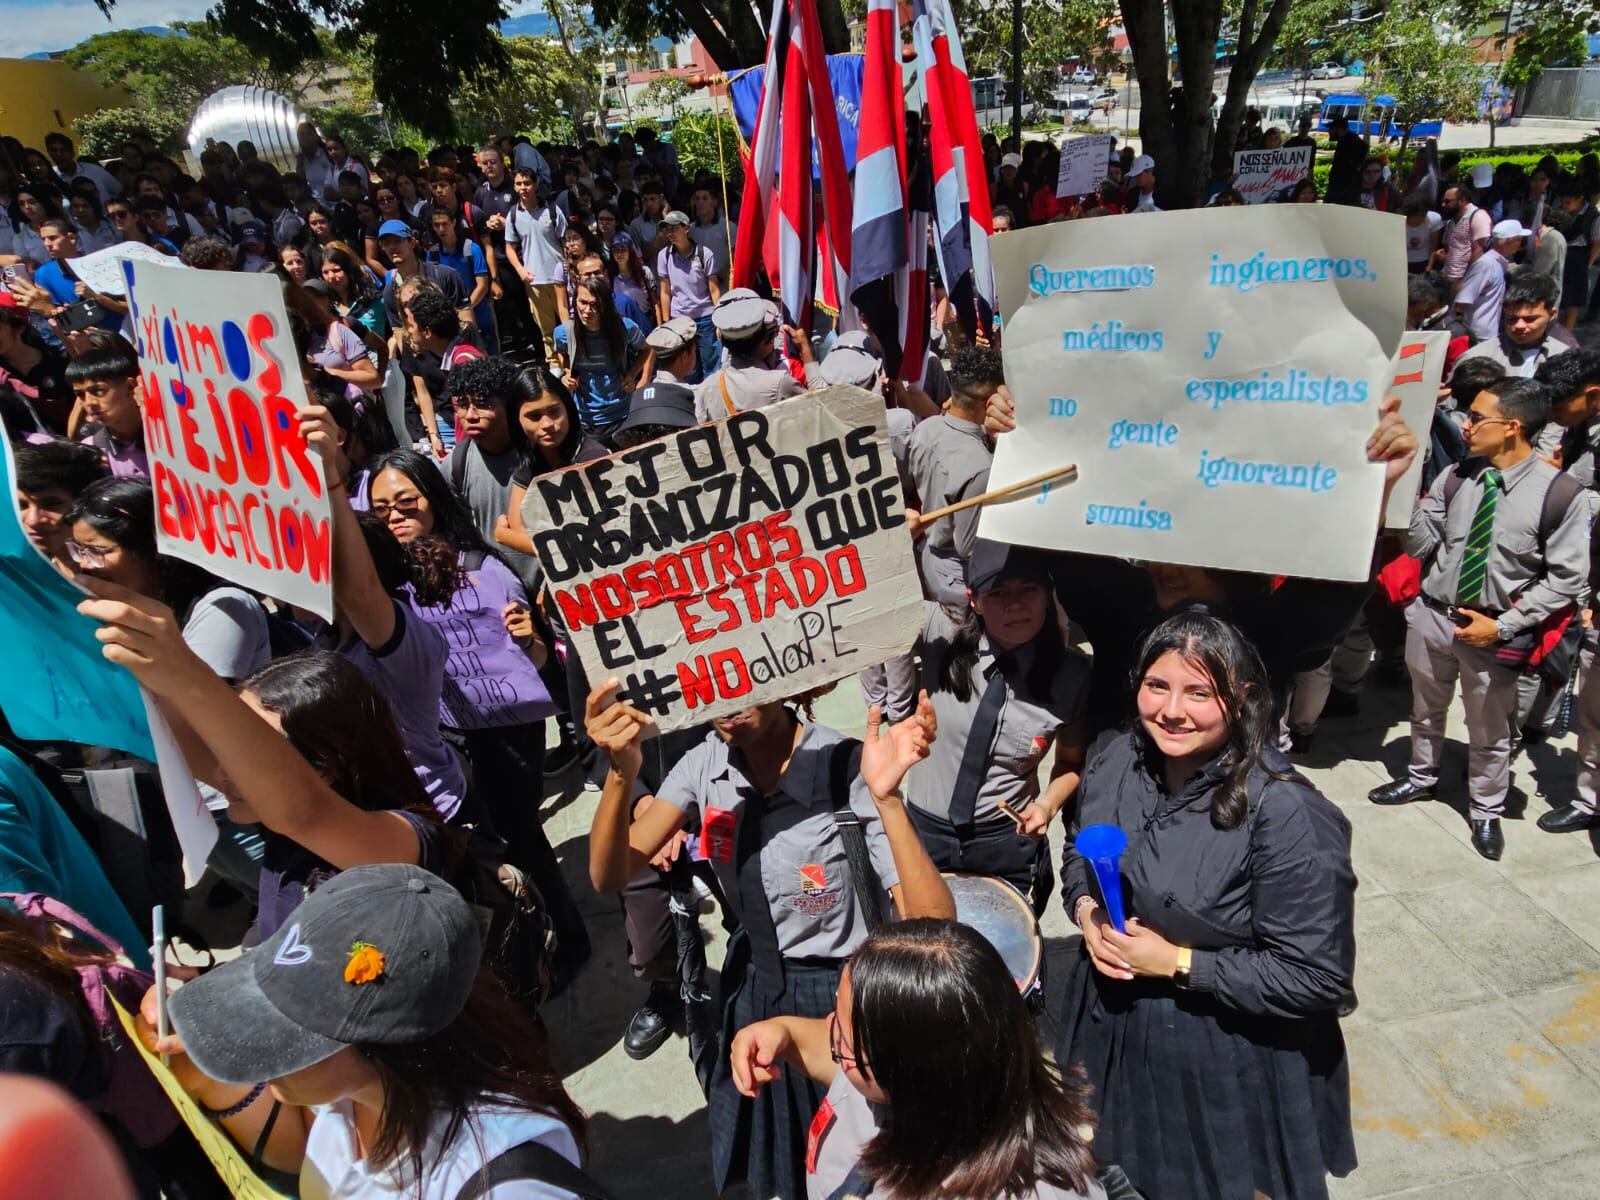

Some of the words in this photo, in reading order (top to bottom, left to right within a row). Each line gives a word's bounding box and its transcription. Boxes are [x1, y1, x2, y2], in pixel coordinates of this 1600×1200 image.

[1028, 263, 1156, 296] Queremos
[1208, 251, 1378, 291] ingieneros,
[1062, 320, 1165, 352] médicos
[1203, 328, 1224, 359] y
[1185, 369, 1369, 409] especialistas
[1049, 395, 1078, 417] no
[1107, 417, 1179, 450] gente
[536, 410, 776, 527] MEJOR
[1196, 449, 1338, 492] ignorante
[533, 425, 883, 583] ORGANIZADOS
[1085, 500, 1173, 531] sumisa
[555, 509, 804, 632] NOSOTROS
[805, 475, 907, 551] QUE
[593, 614, 667, 669] EL
[675, 543, 868, 645] ESTADO
